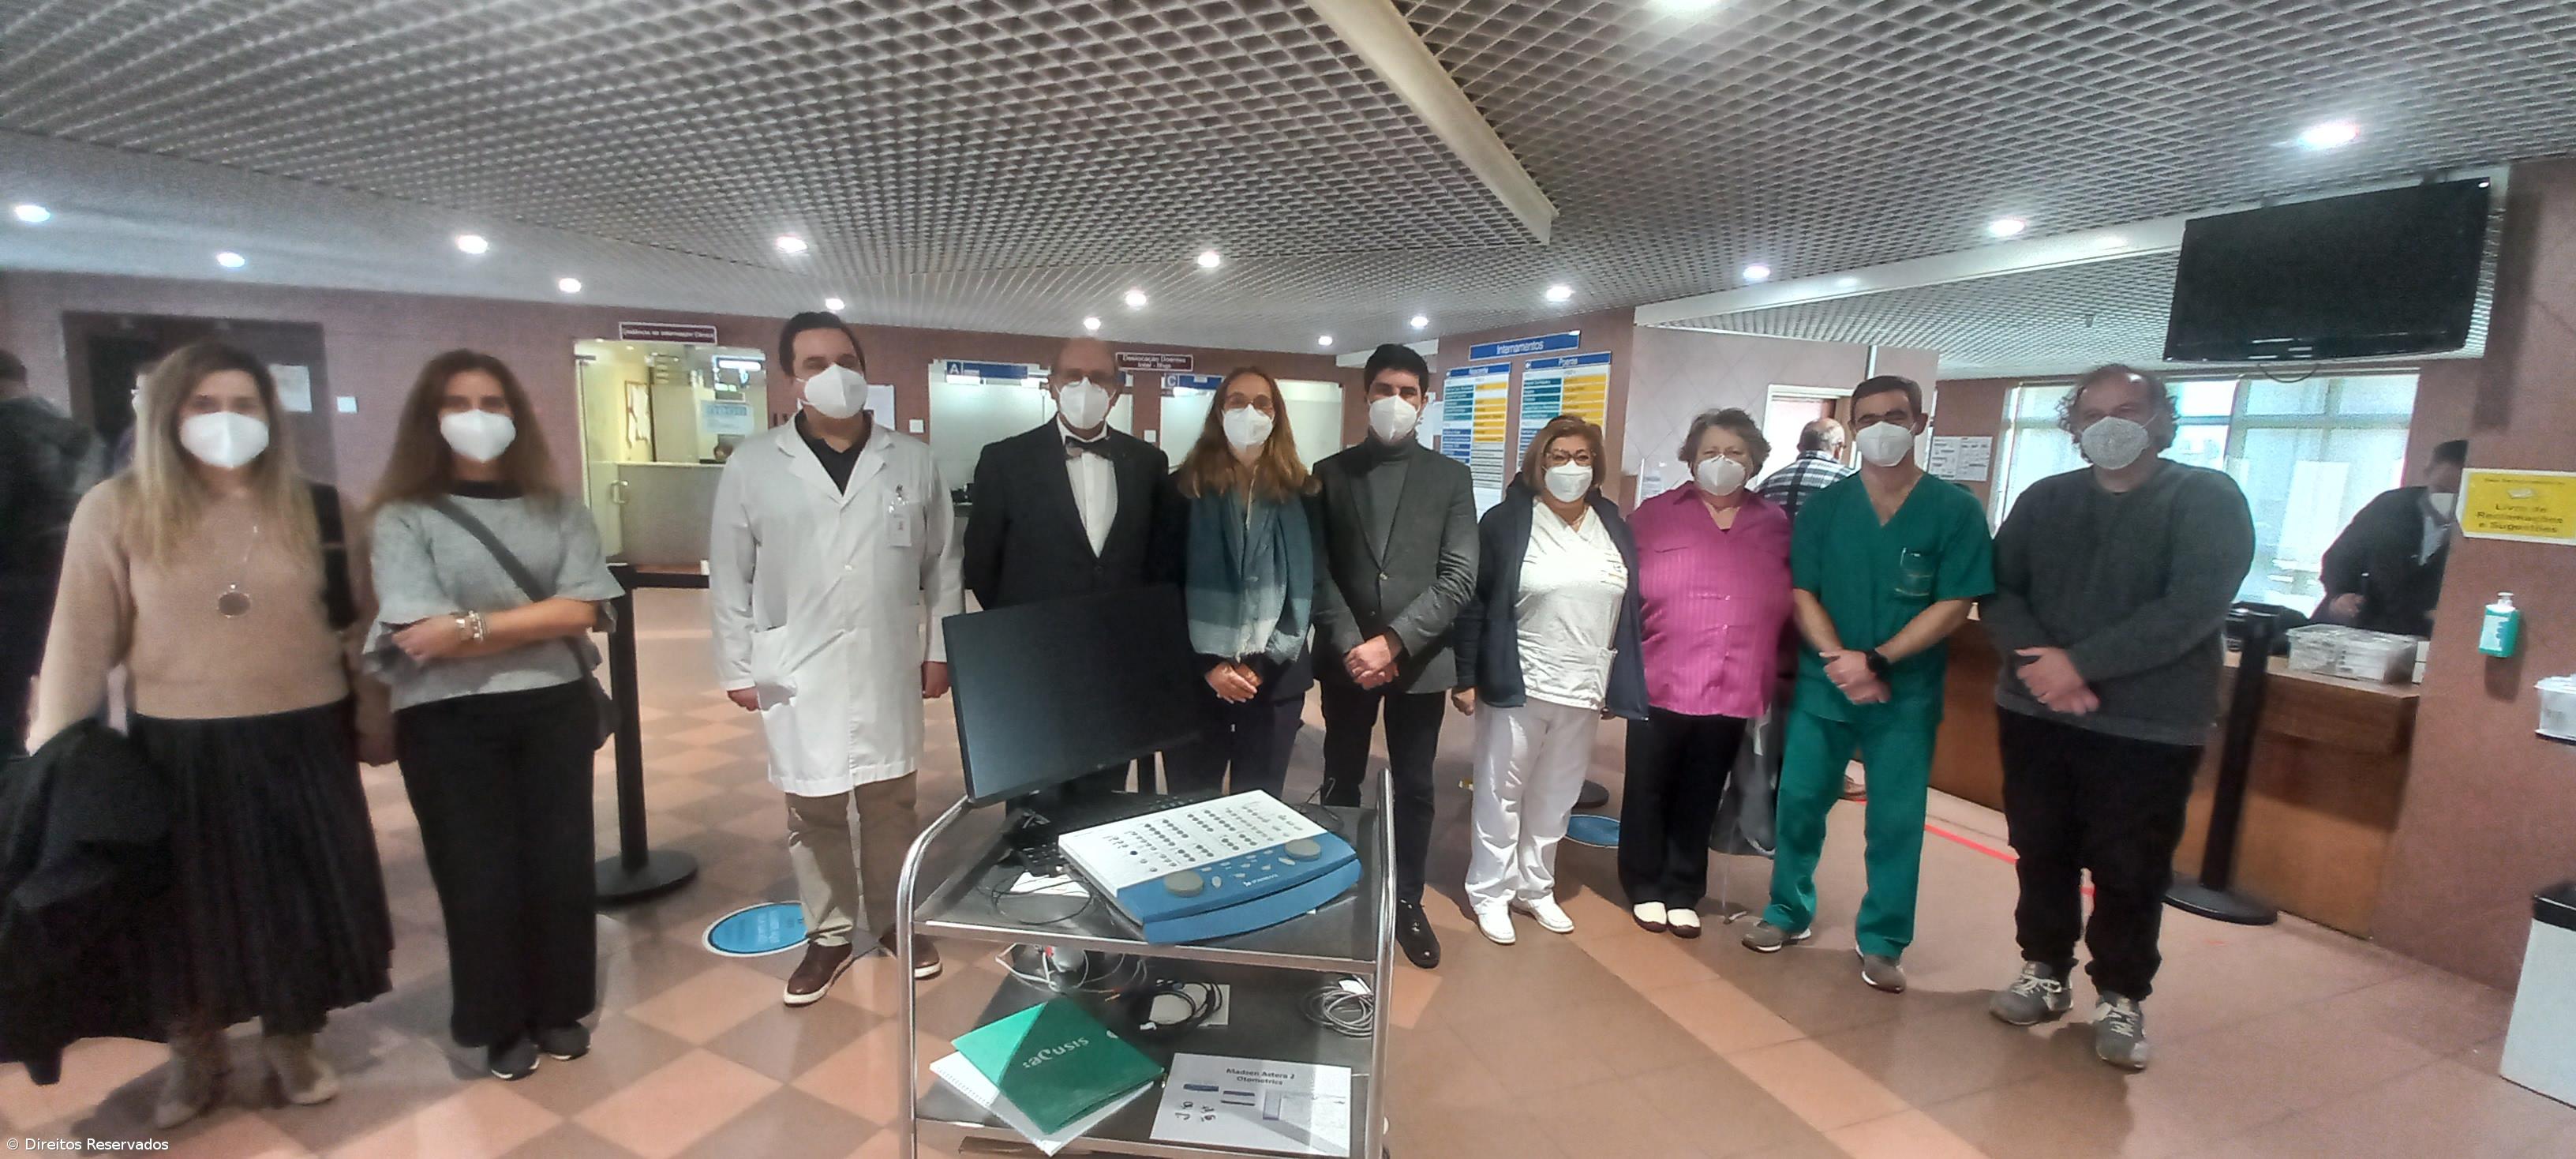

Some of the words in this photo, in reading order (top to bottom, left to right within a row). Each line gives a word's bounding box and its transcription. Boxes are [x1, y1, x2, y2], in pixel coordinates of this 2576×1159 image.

[1496, 340, 1544, 354] Internamentos
[949, 363, 960, 375] A
[1167, 375, 1177, 387] C
